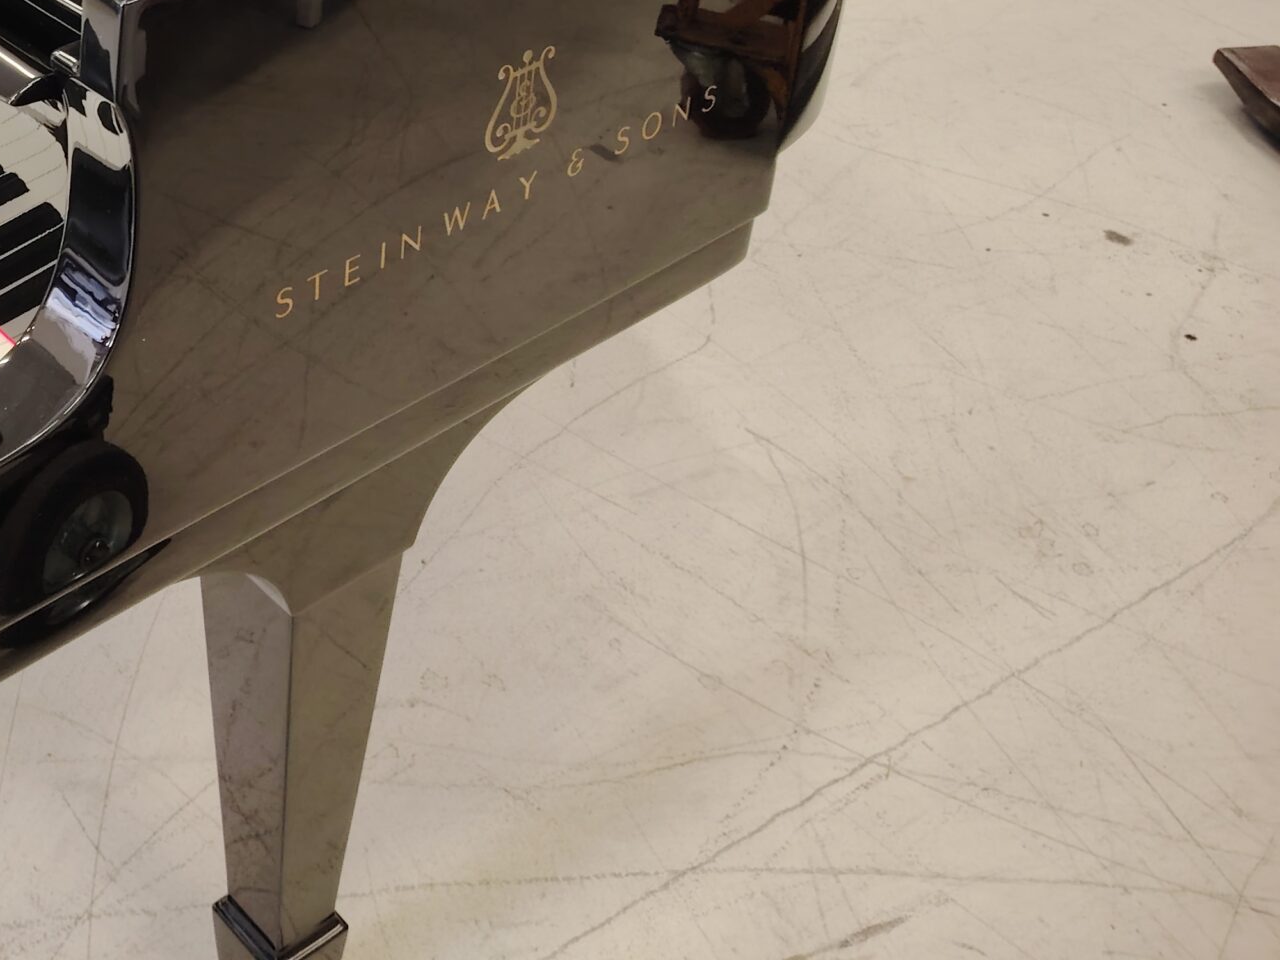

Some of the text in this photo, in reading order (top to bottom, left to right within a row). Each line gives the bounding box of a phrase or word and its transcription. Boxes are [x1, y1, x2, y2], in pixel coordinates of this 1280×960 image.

[275, 85, 718, 318] STEINWAY & SONS
